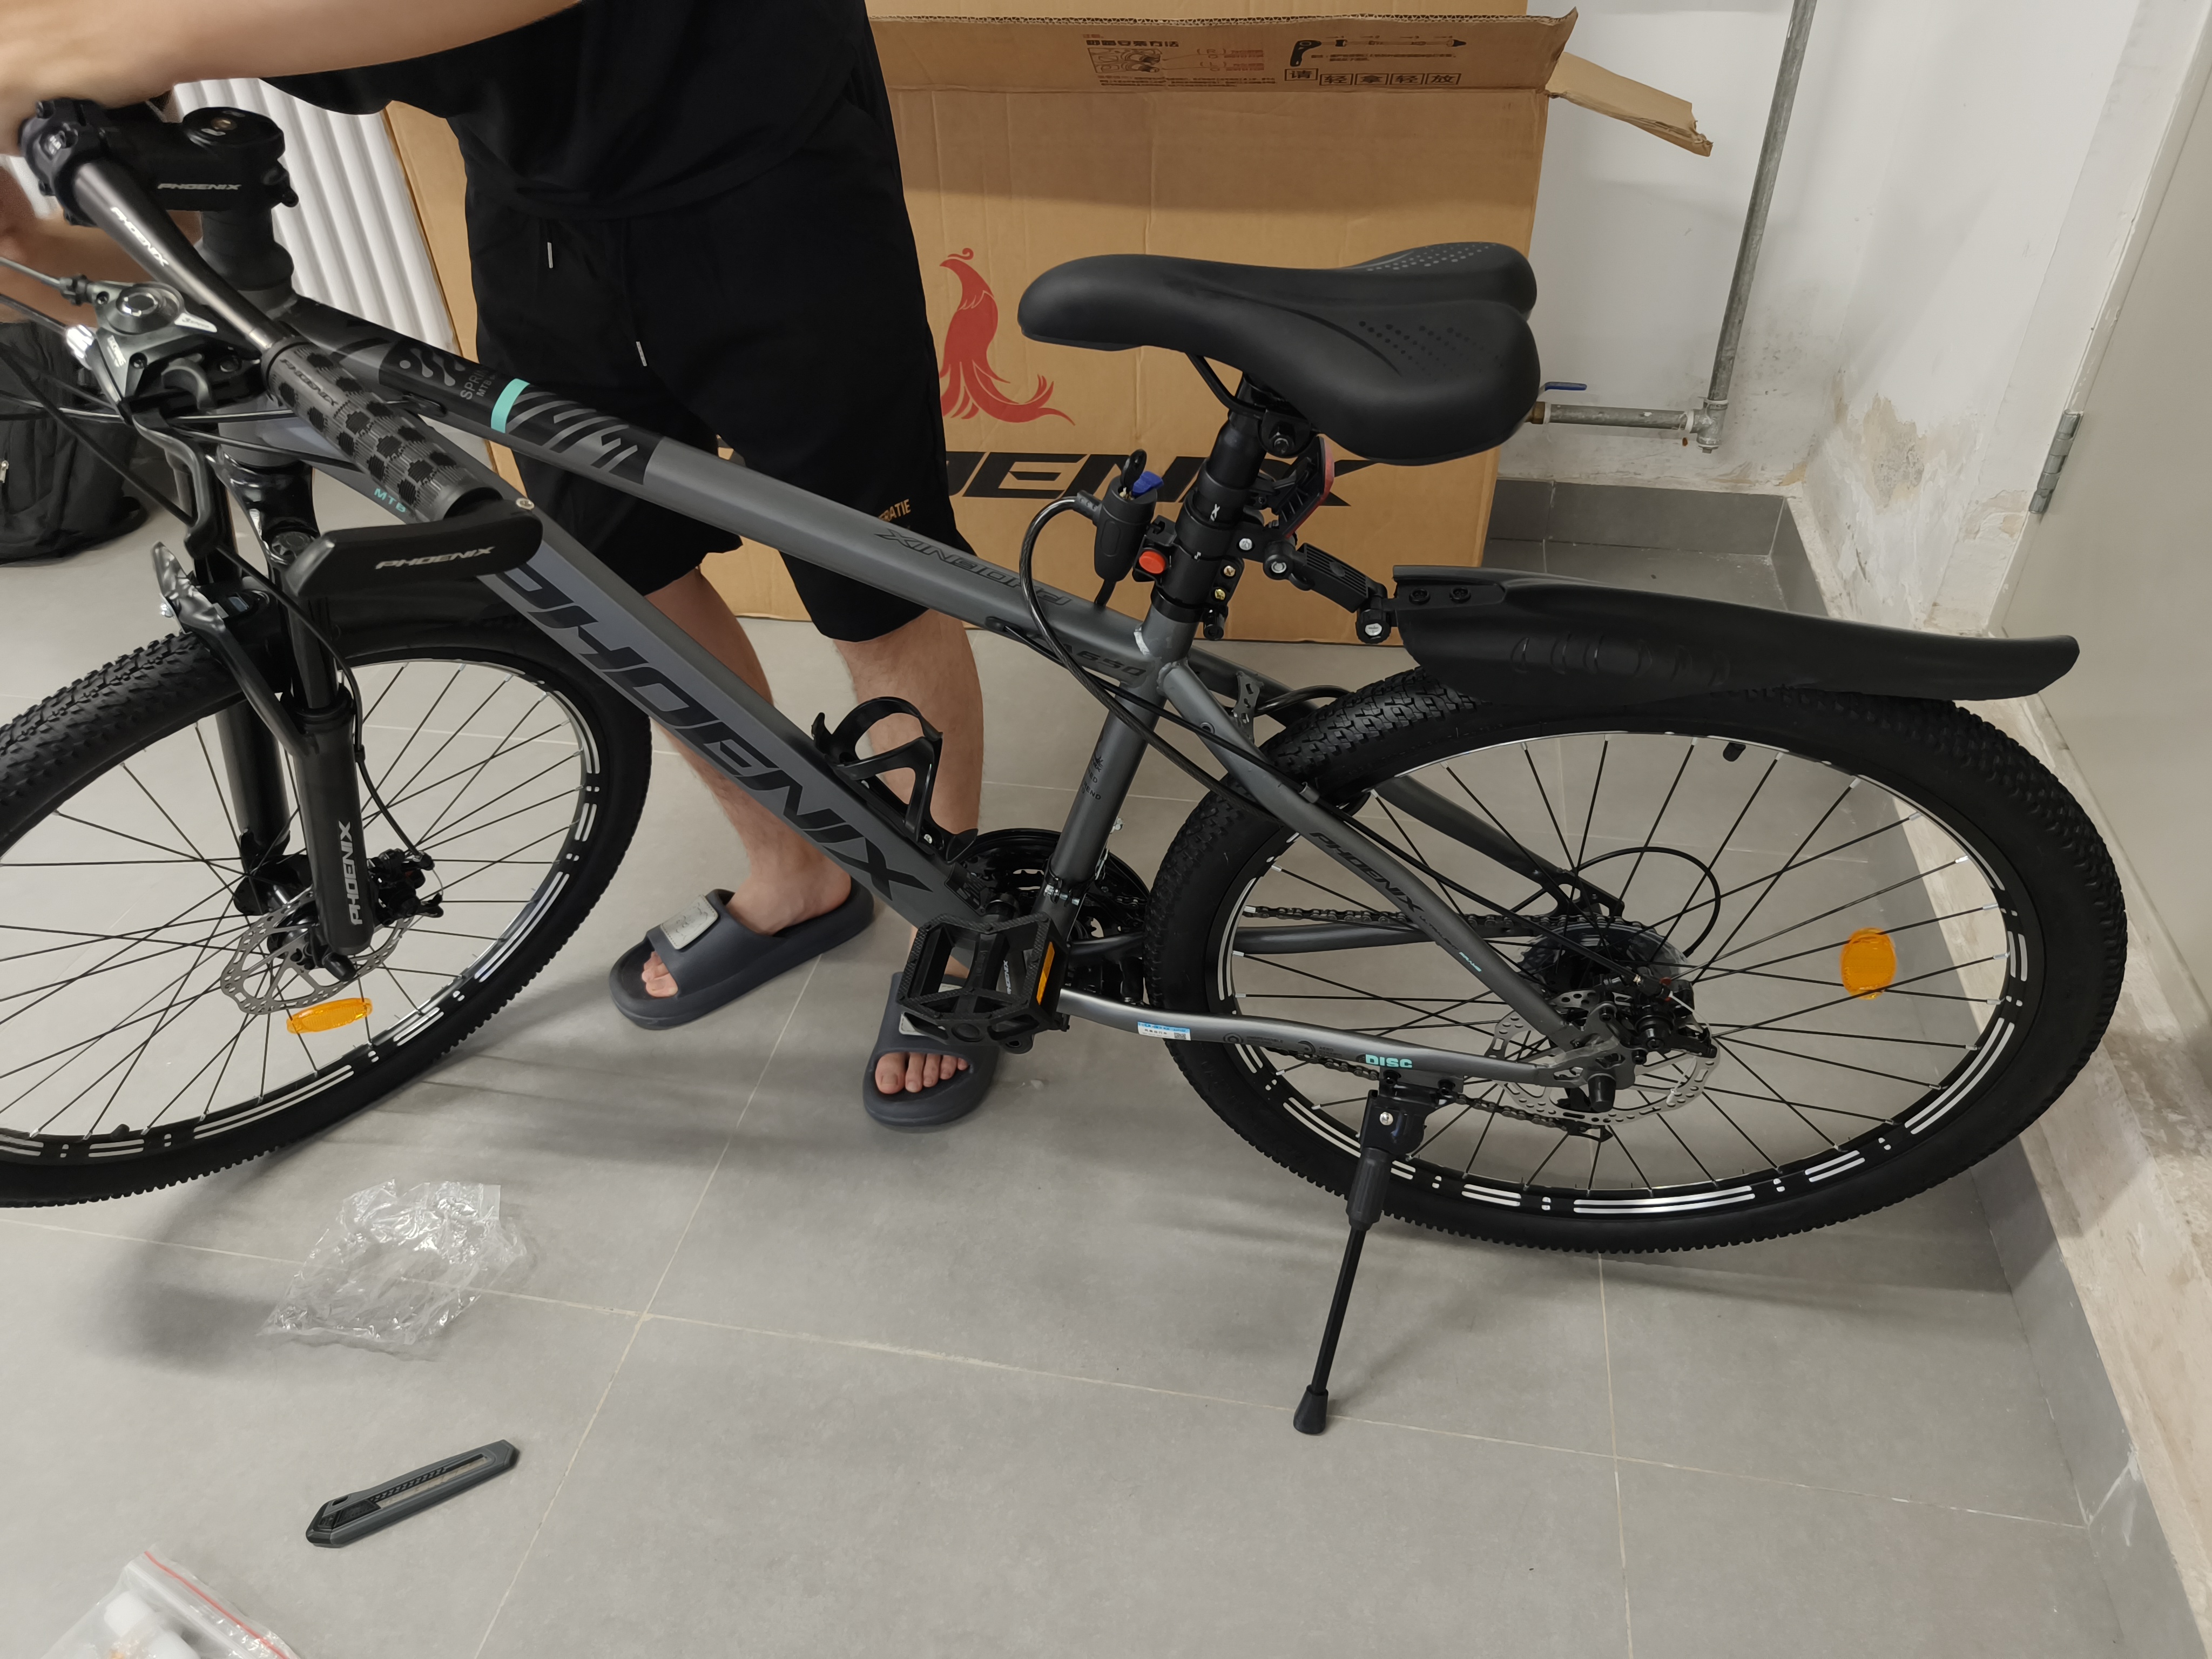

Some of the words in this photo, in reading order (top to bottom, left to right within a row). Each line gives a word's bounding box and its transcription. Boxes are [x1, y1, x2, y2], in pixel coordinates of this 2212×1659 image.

[110, 207, 170, 267] PHOENIX
[279, 359, 339, 406] PHOENIX
[374, 487, 407, 512] MTB
[375, 546, 496, 570] PHOENIX
[494, 562, 934, 901] PHOENIX
[338, 820, 363, 925] PHOENIX
[1309, 832, 1425, 913] PHOENIX
[1365, 1054, 1413, 1068] DISC
